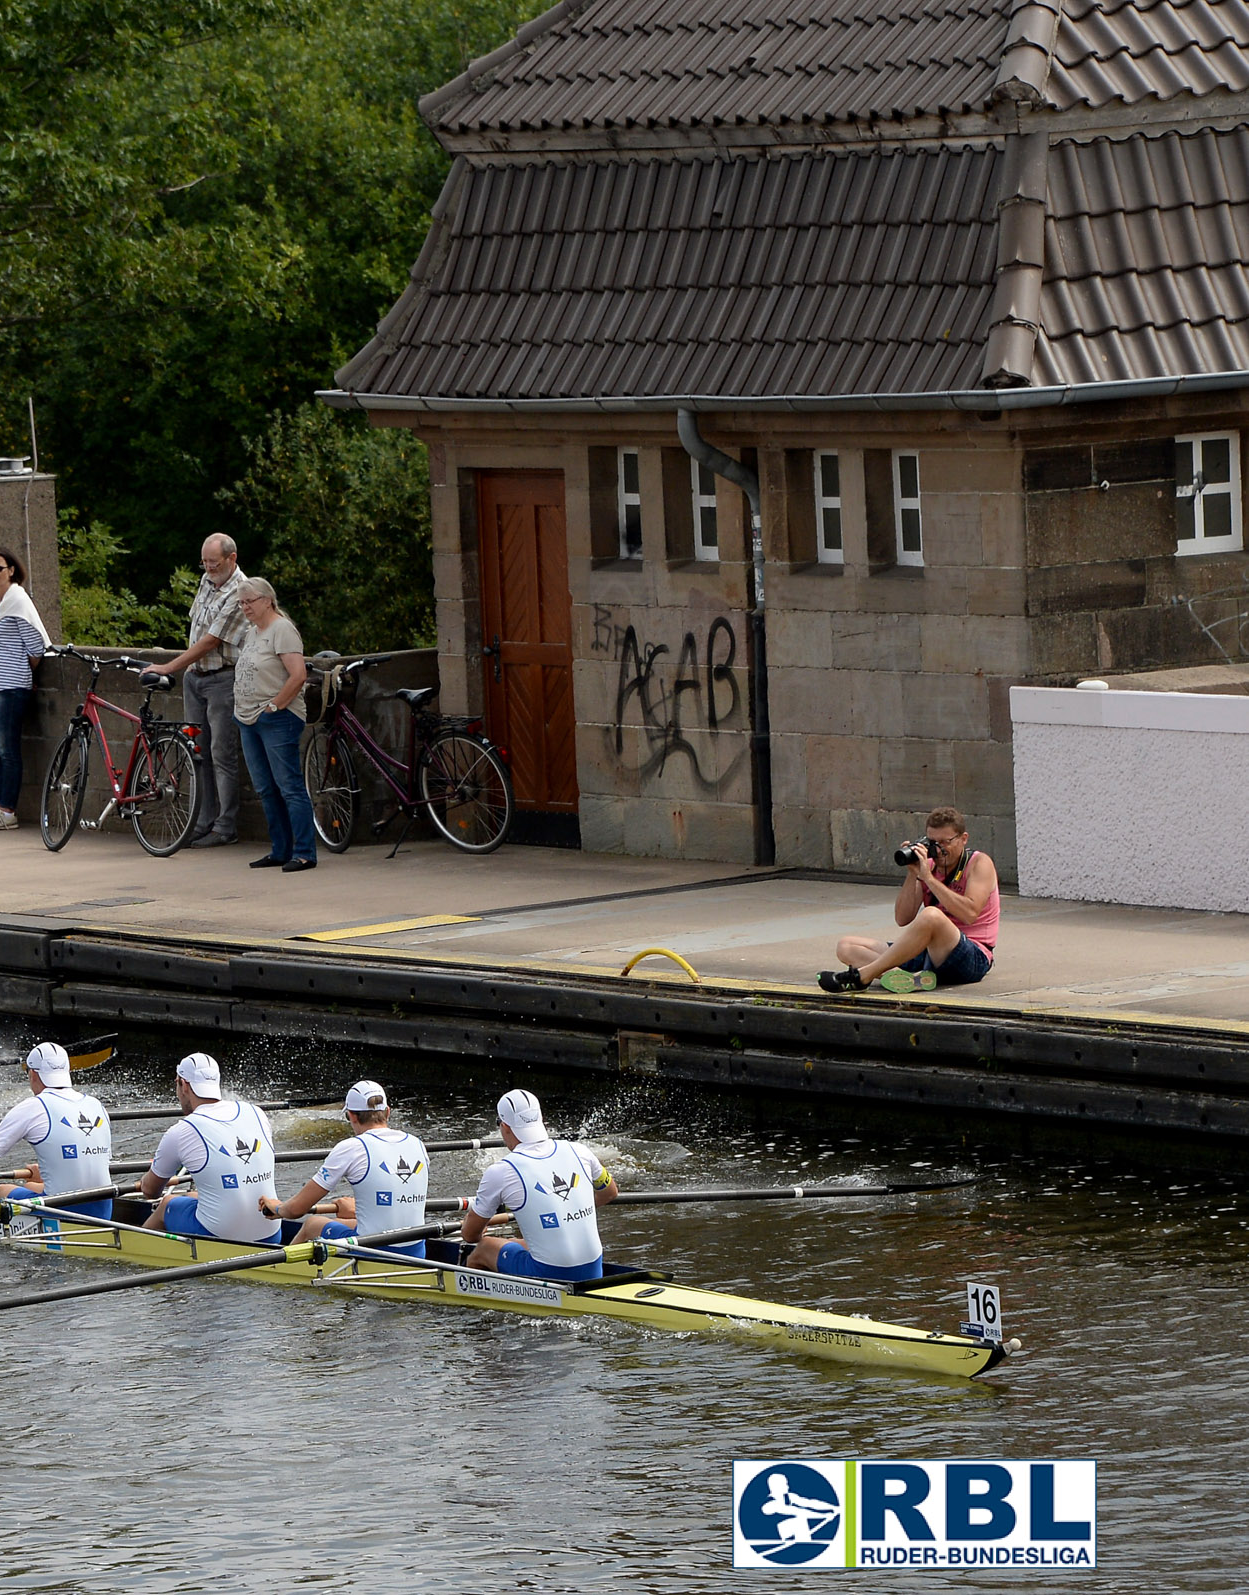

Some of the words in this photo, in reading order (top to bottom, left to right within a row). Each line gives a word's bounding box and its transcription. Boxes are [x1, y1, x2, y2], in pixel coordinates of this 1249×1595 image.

[242, 1170, 272, 1185] -Achter
[396, 1193, 426, 1204] -Achter
[562, 1205, 594, 1222] -Achter
[470, 1276, 491, 1291] RBL
[492, 1282, 557, 1300] RUDER-BUNDESLIGA
[971, 1288, 997, 1324] 16
